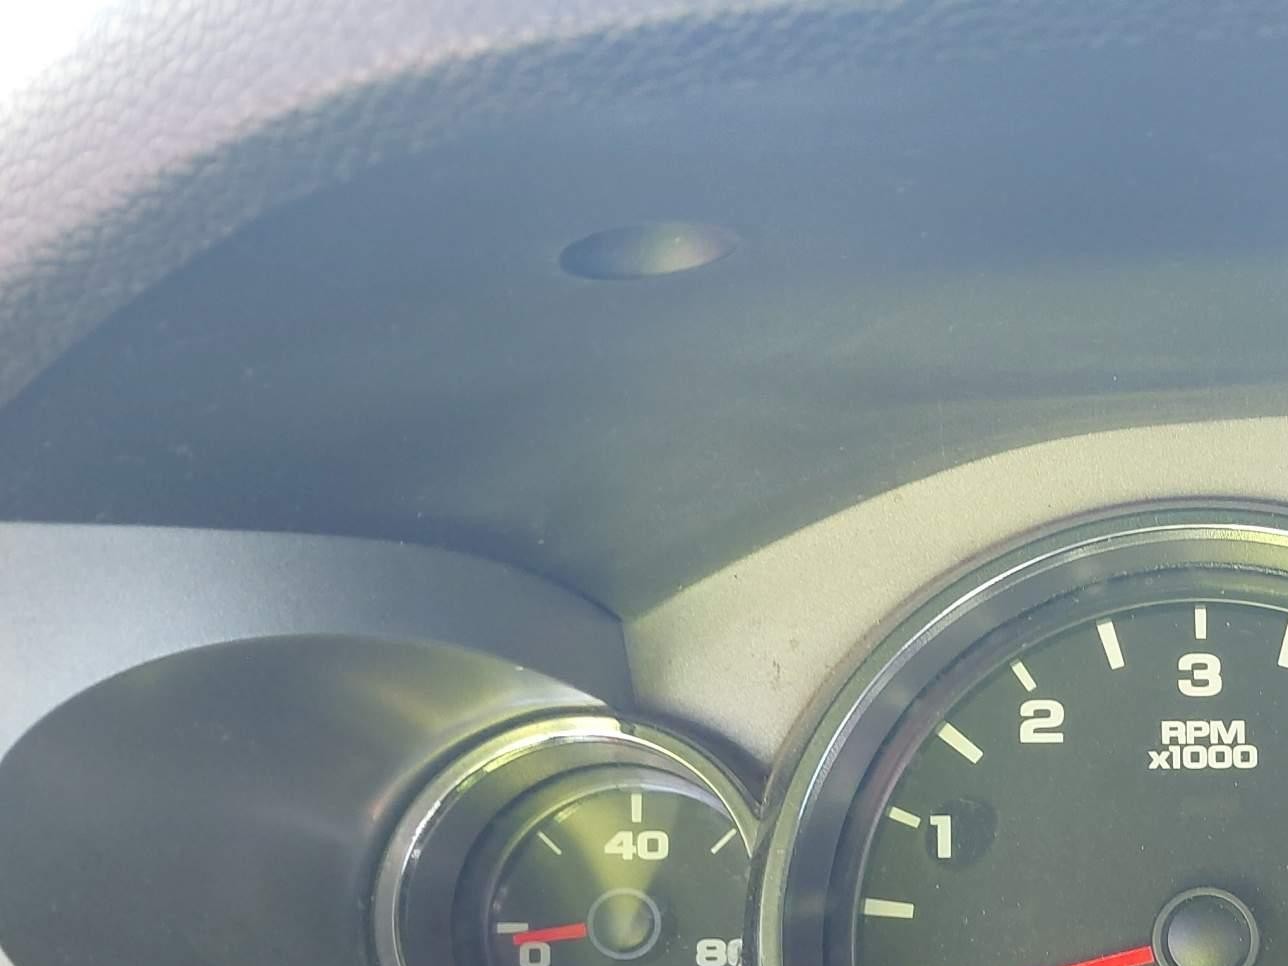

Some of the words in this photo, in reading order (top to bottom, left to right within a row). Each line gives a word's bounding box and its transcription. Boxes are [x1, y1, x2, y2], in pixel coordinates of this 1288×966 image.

[1177, 653, 1222, 697] 3
[1018, 700, 1065, 744] 2
[1160, 720, 1246, 744] RPM
[1147, 744, 1259, 770] x1000
[604, 831, 669, 860] 40
[930, 815, 952, 859] 1
